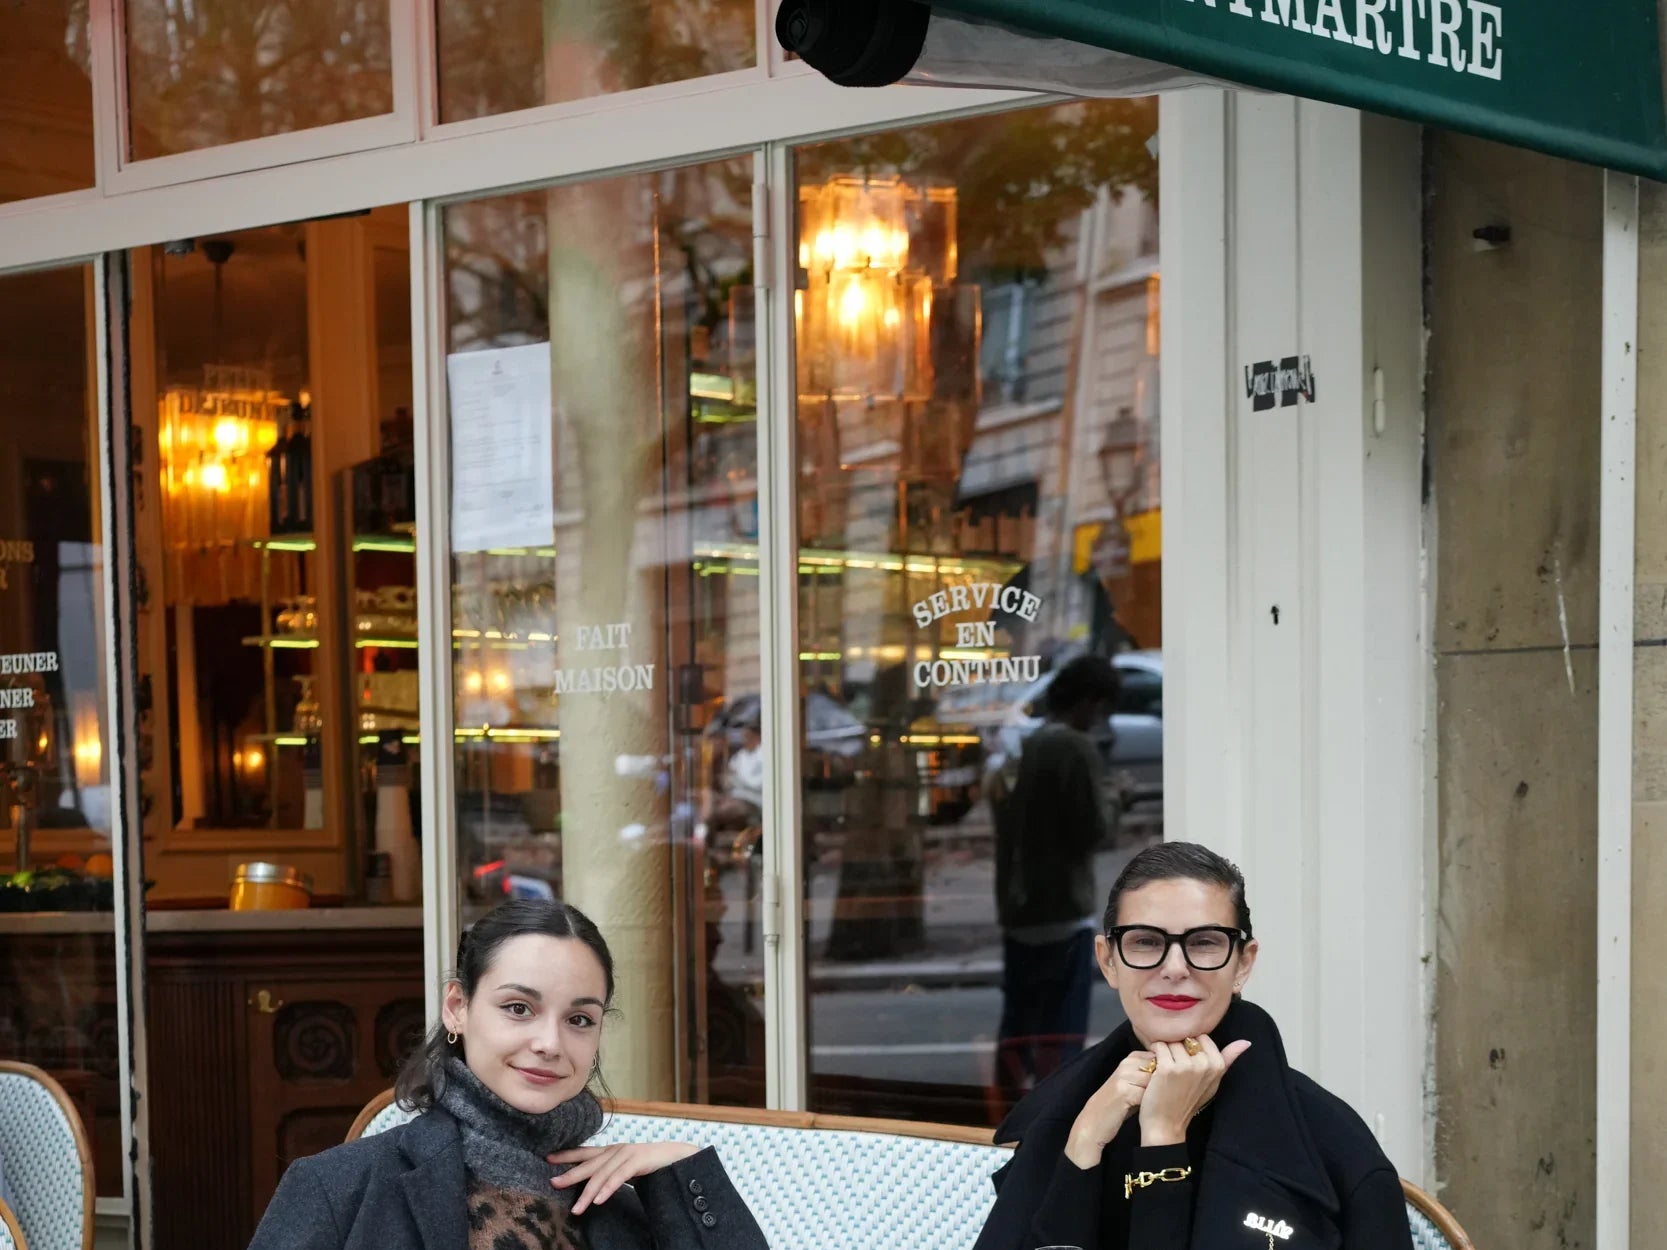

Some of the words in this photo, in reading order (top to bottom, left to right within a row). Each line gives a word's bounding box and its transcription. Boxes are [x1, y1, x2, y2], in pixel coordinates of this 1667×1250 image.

[1184, 0, 1504, 82] ARTRE
[912, 582, 1042, 629] SERVICE
[575, 622, 632, 651] FAIT
[955, 620, 997, 648] EN
[0, 651, 59, 674] EUNER
[912, 655, 1042, 688] CONTINU
[553, 663, 656, 694] MAISON
[0, 687, 35, 709] NER
